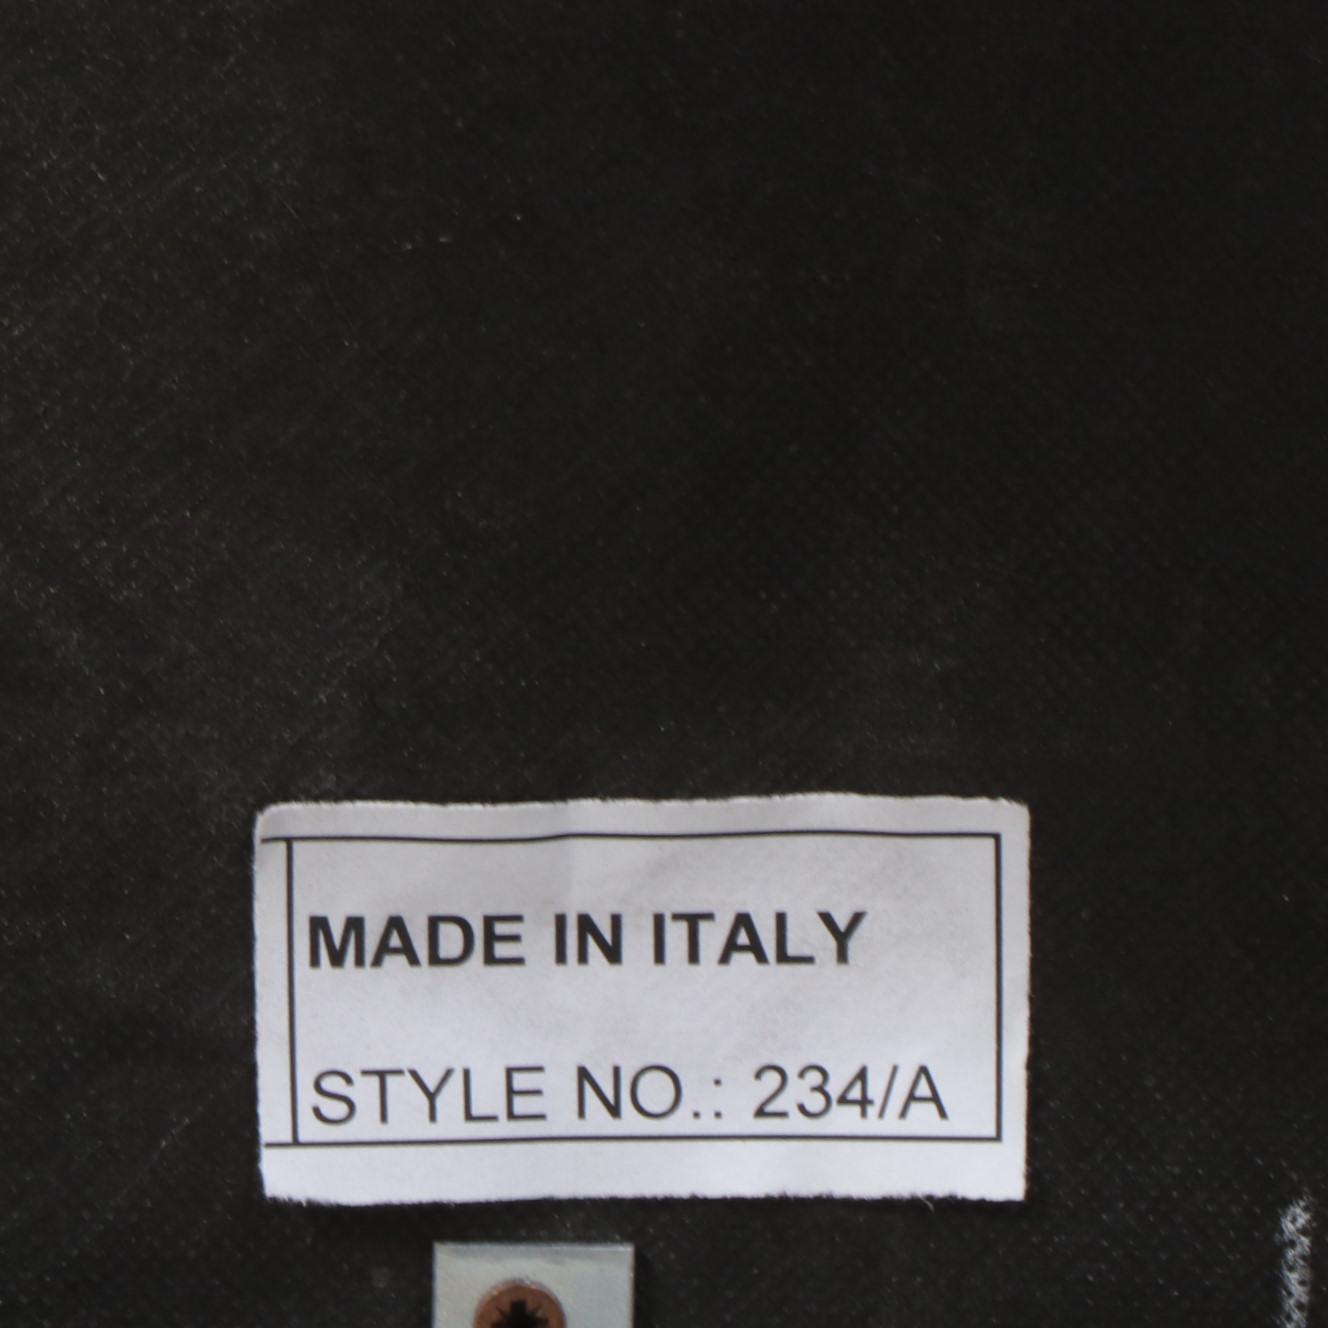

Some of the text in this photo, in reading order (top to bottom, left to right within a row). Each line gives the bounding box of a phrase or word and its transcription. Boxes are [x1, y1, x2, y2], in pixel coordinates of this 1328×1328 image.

[307, 910, 867, 969] MADE IN ITALY
[310, 1063, 950, 1125] STYLE NO.: 234/A
